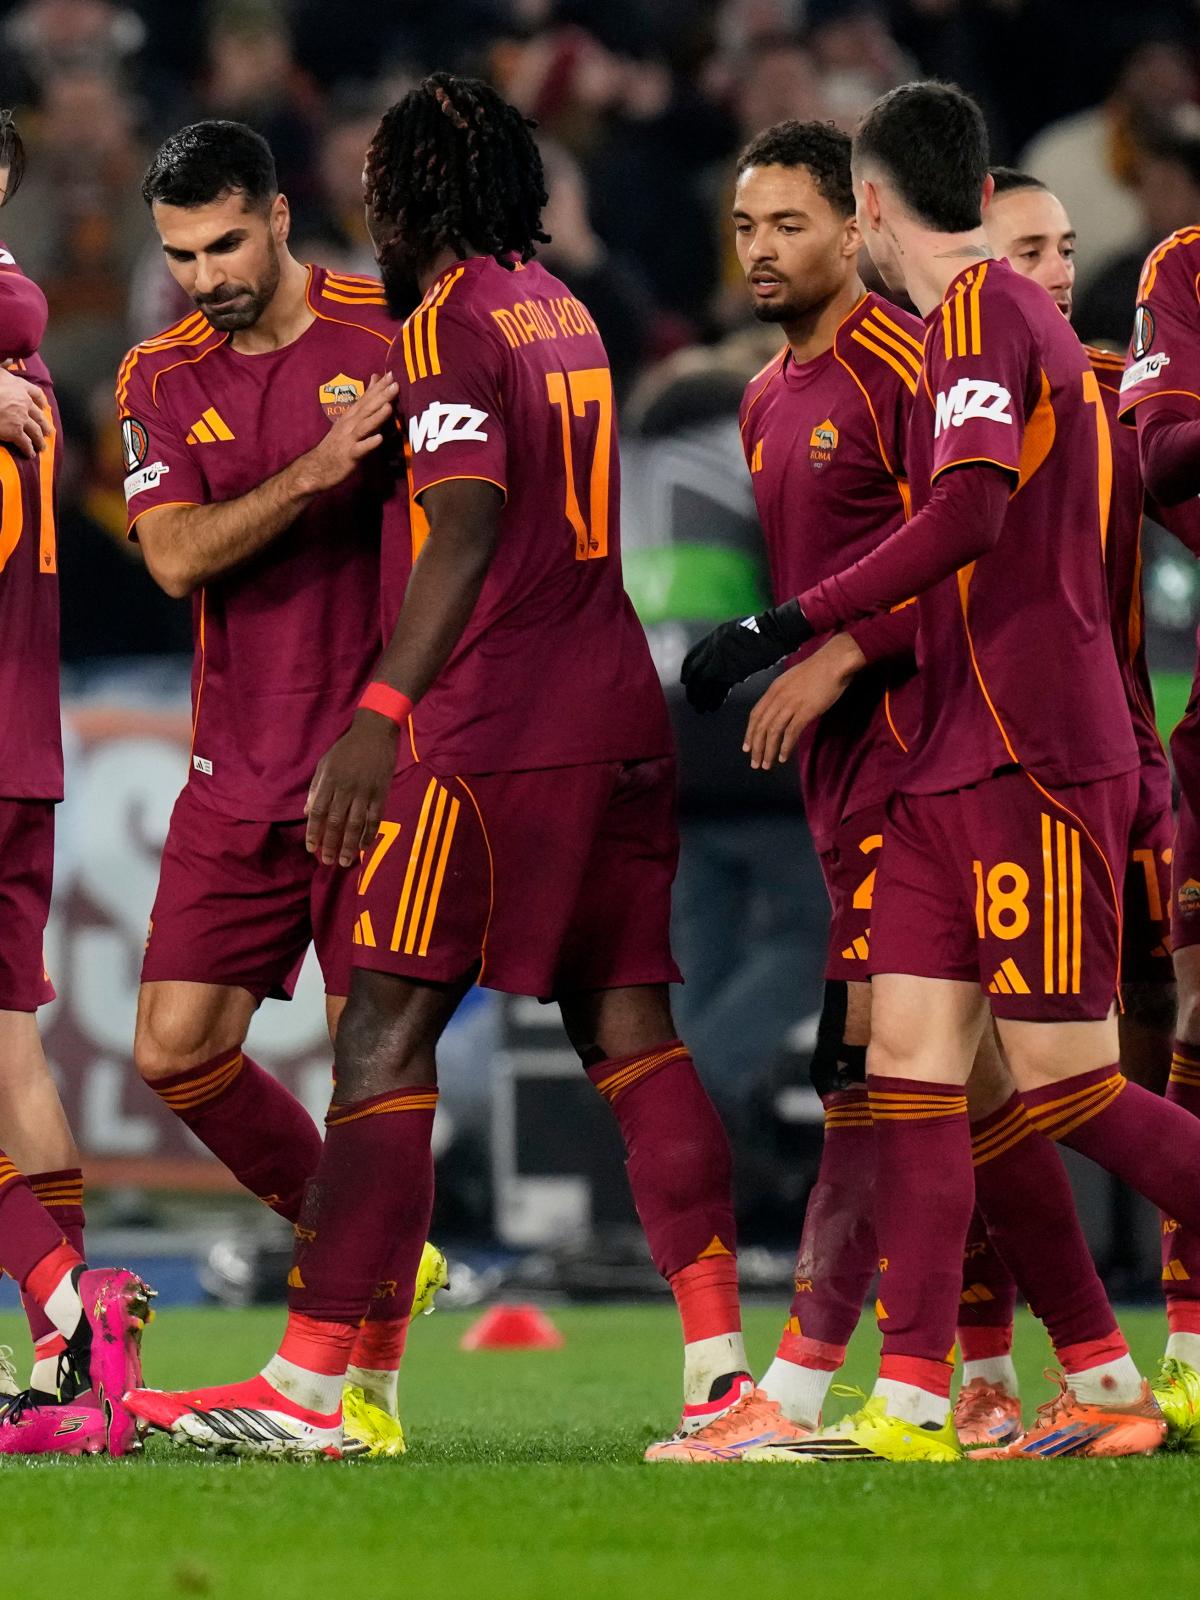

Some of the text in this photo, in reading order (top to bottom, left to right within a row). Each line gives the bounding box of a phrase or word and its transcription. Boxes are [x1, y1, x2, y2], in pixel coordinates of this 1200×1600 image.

[490, 296, 599, 349] MANU KON
[1146, 360, 1160, 373] 10
[326, 405, 352, 416] ROM
[142, 470, 158, 484] 10
[545, 367, 612, 560] 17
[810, 450, 832, 461] ROMA
[1082, 370, 1114, 566] 1
[357, 820, 402, 896] 7
[1132, 848, 1173, 921] 1
[972, 860, 1030, 940] 18
